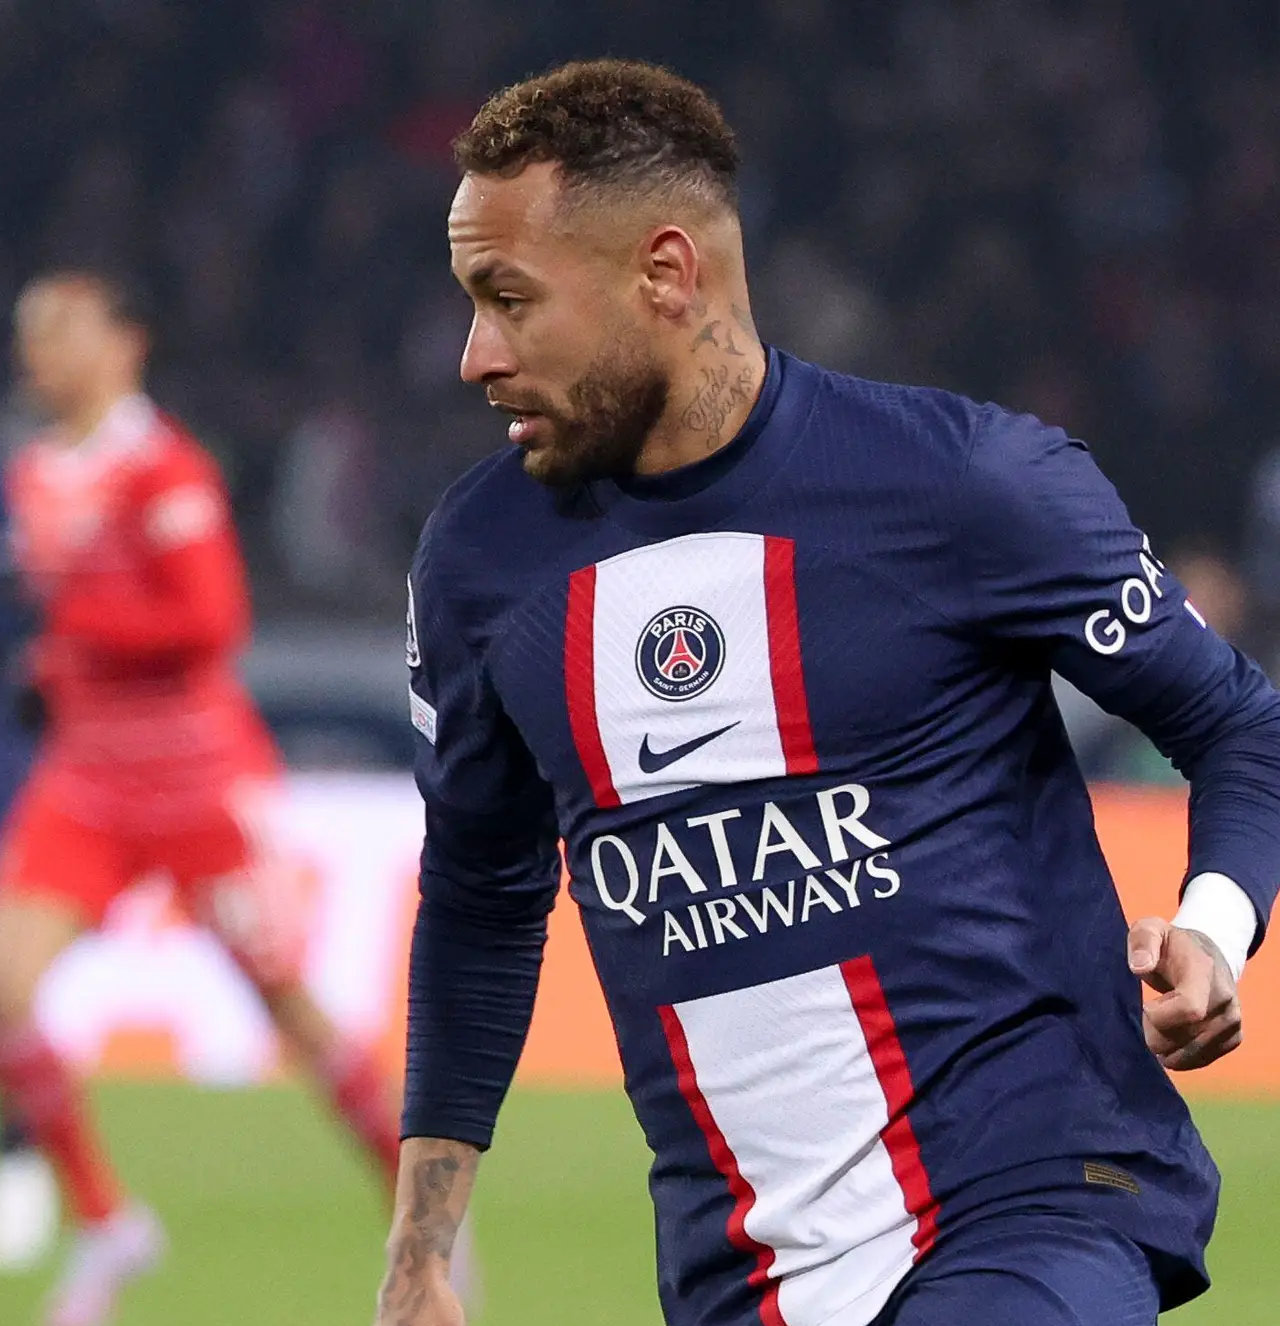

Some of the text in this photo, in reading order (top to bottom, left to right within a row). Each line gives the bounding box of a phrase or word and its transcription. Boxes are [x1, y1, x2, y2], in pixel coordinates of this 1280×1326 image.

[650, 612, 707, 639] PARIS
[590, 783, 892, 926] QATAR
[661, 852, 902, 956] AIRWAYS
